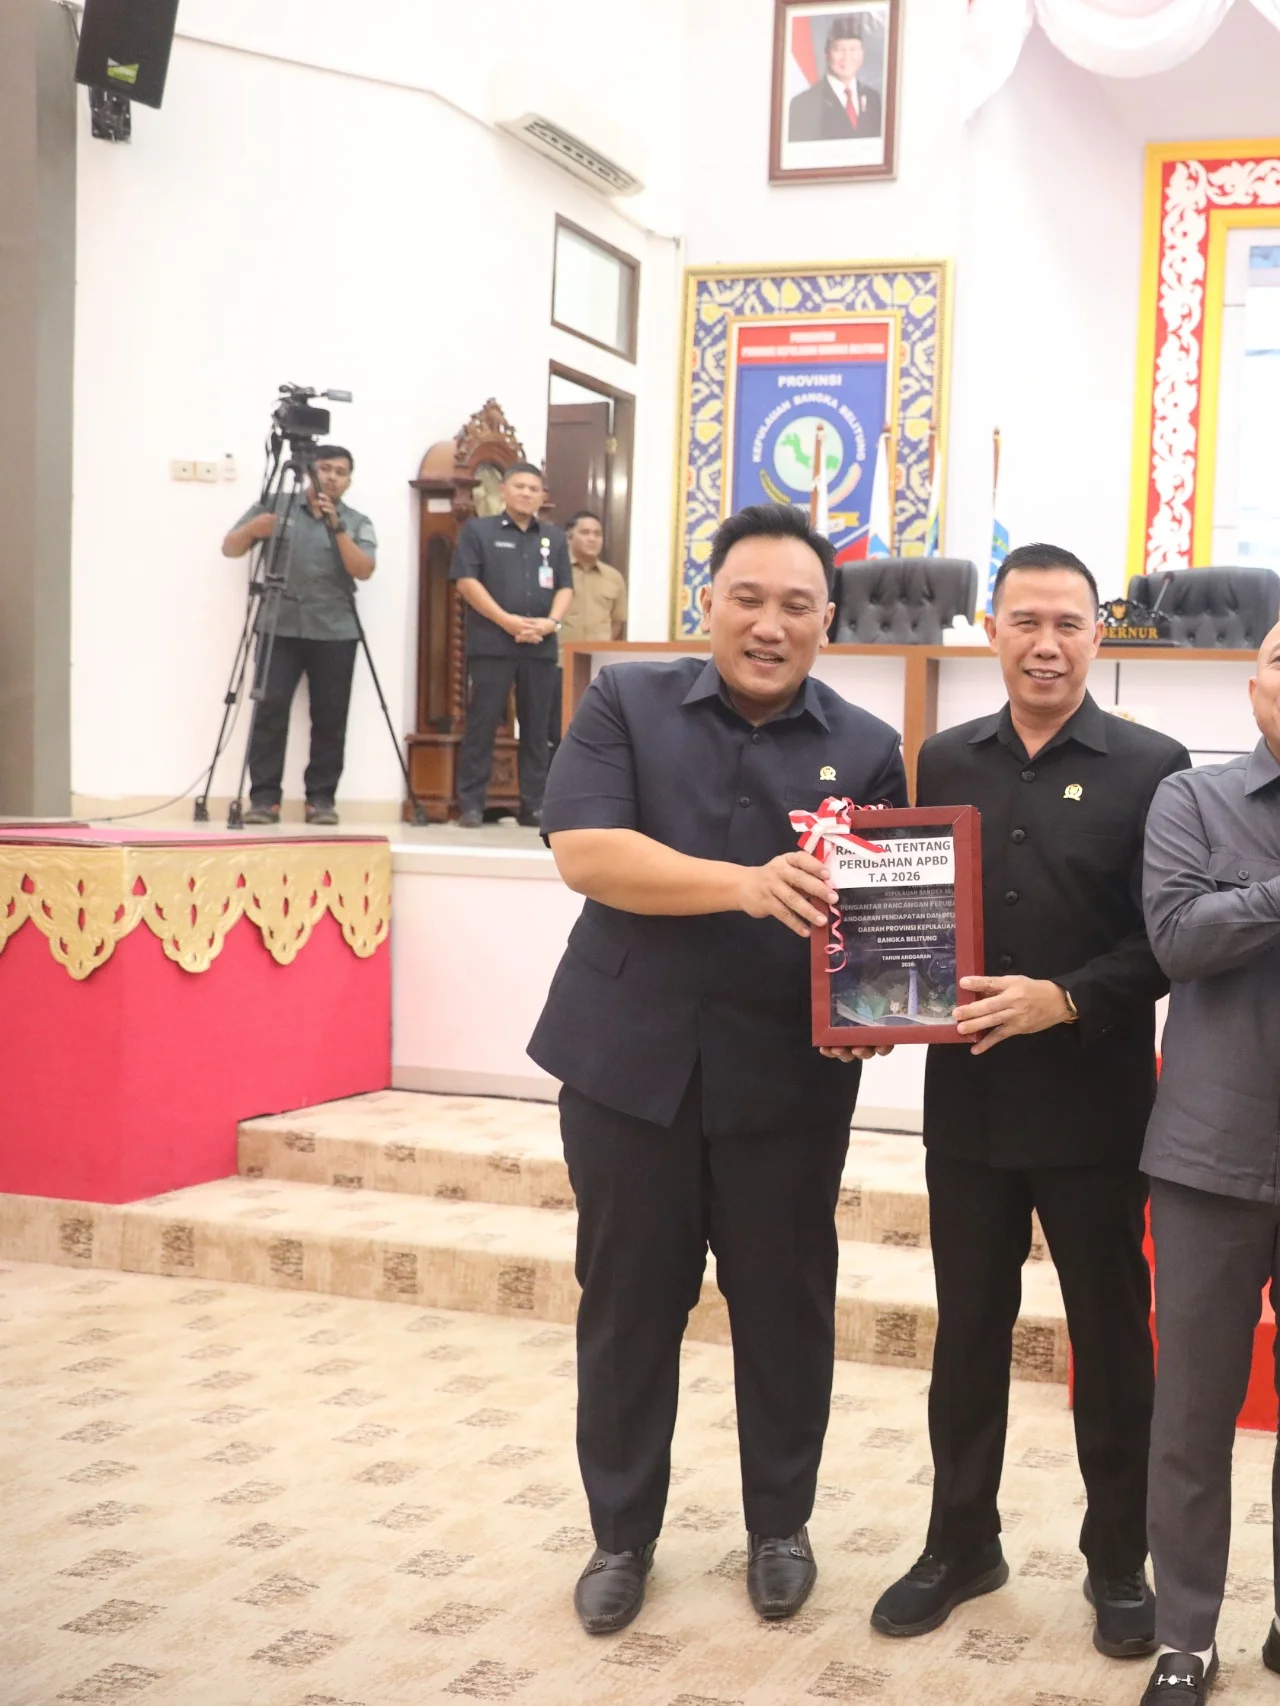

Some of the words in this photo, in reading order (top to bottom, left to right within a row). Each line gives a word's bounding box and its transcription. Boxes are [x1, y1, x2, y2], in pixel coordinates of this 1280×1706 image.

[895, 840, 951, 853] TENTANG
[839, 857, 912, 870] PERUBAHAN
[916, 855, 948, 867] APBD
[868, 873, 888, 883] T.A
[891, 871, 921, 882] 2026
[840, 902, 881, 911] PENGANTAR
[883, 901, 928, 910] RANCANGAN
[843, 914, 881, 922] ANGGARAN
[881, 913, 926, 921] PENDAPATAN
[926, 912, 941, 920] DAN
[858, 925, 885, 933] DAERAH
[885, 924, 917, 932] PROVINSI
[877, 936, 905, 944] BANGKA
[906, 935, 937, 943] BELITUNG
